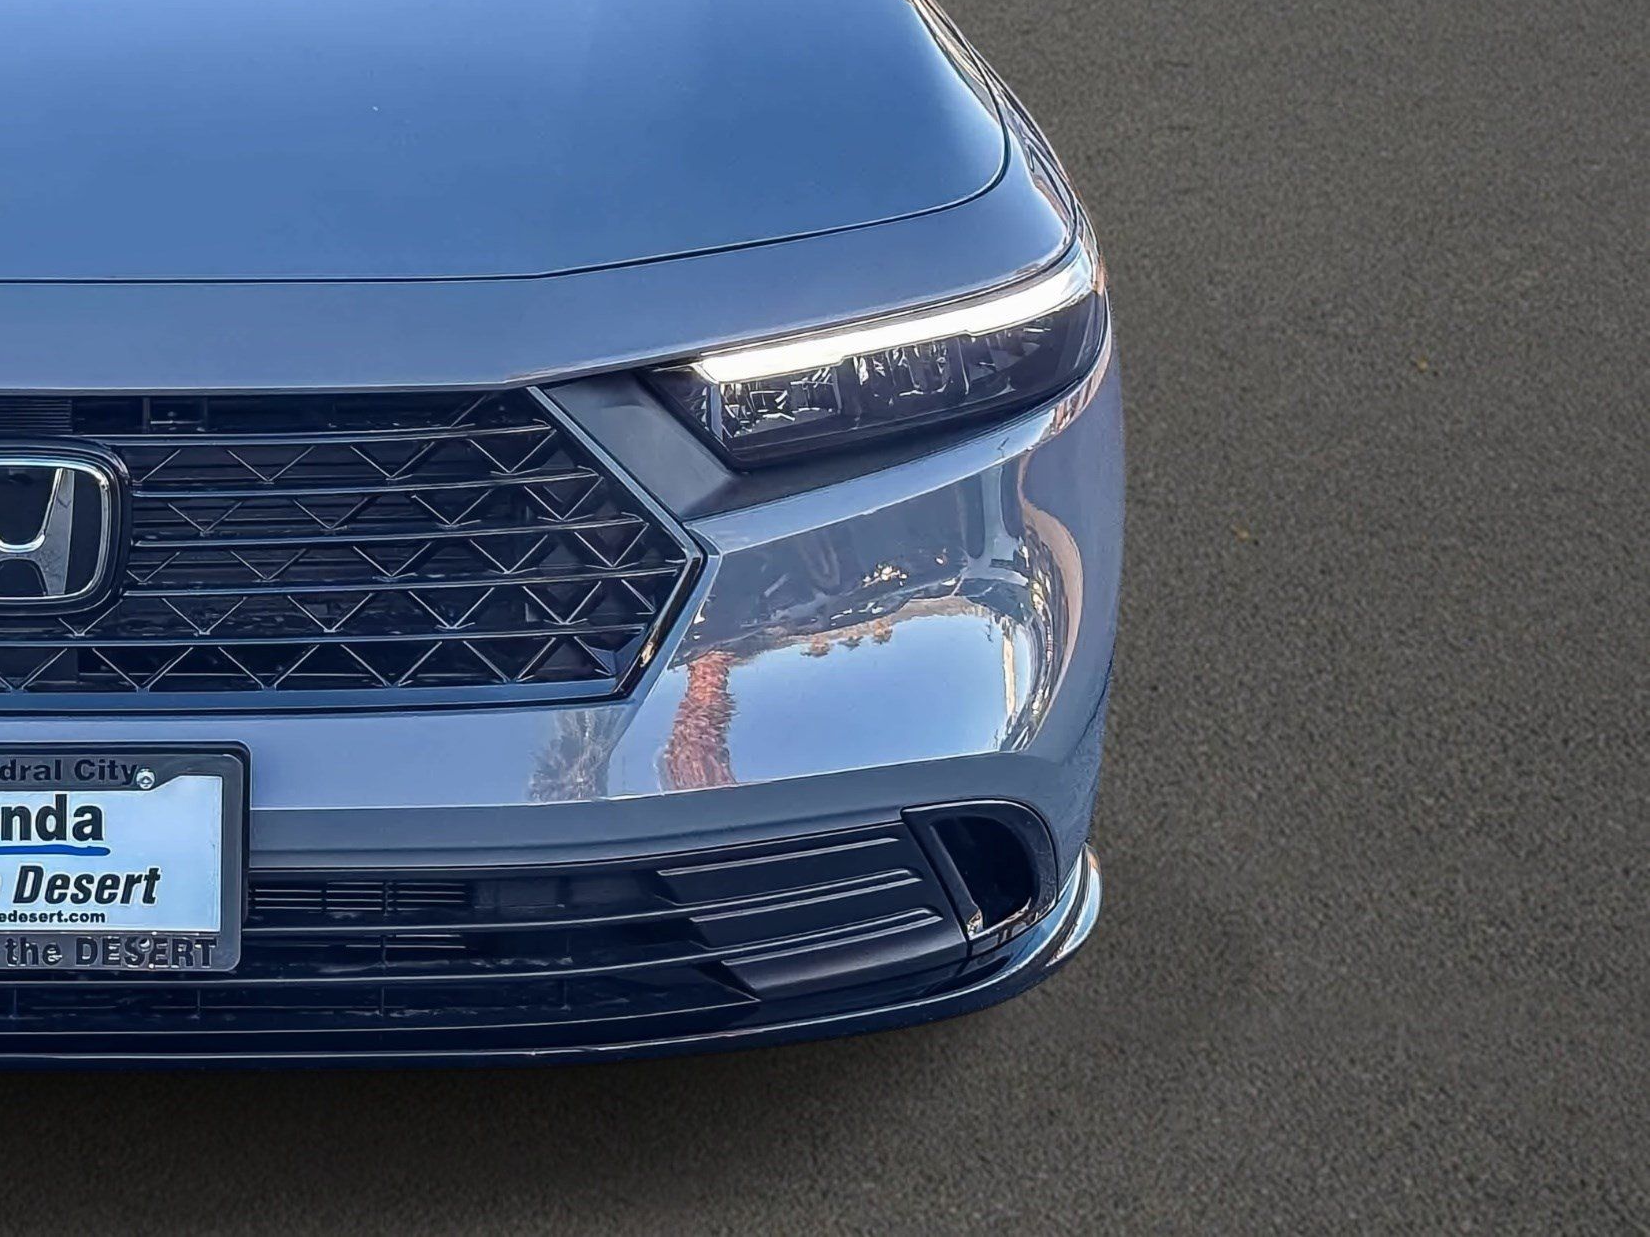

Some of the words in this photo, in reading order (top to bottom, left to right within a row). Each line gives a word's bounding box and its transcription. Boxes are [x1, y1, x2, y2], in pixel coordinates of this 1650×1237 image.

[73, 758, 138, 786] City
[12, 866, 161, 905] Desert
[3, 936, 63, 968] the
[75, 936, 218, 969] DESERT
